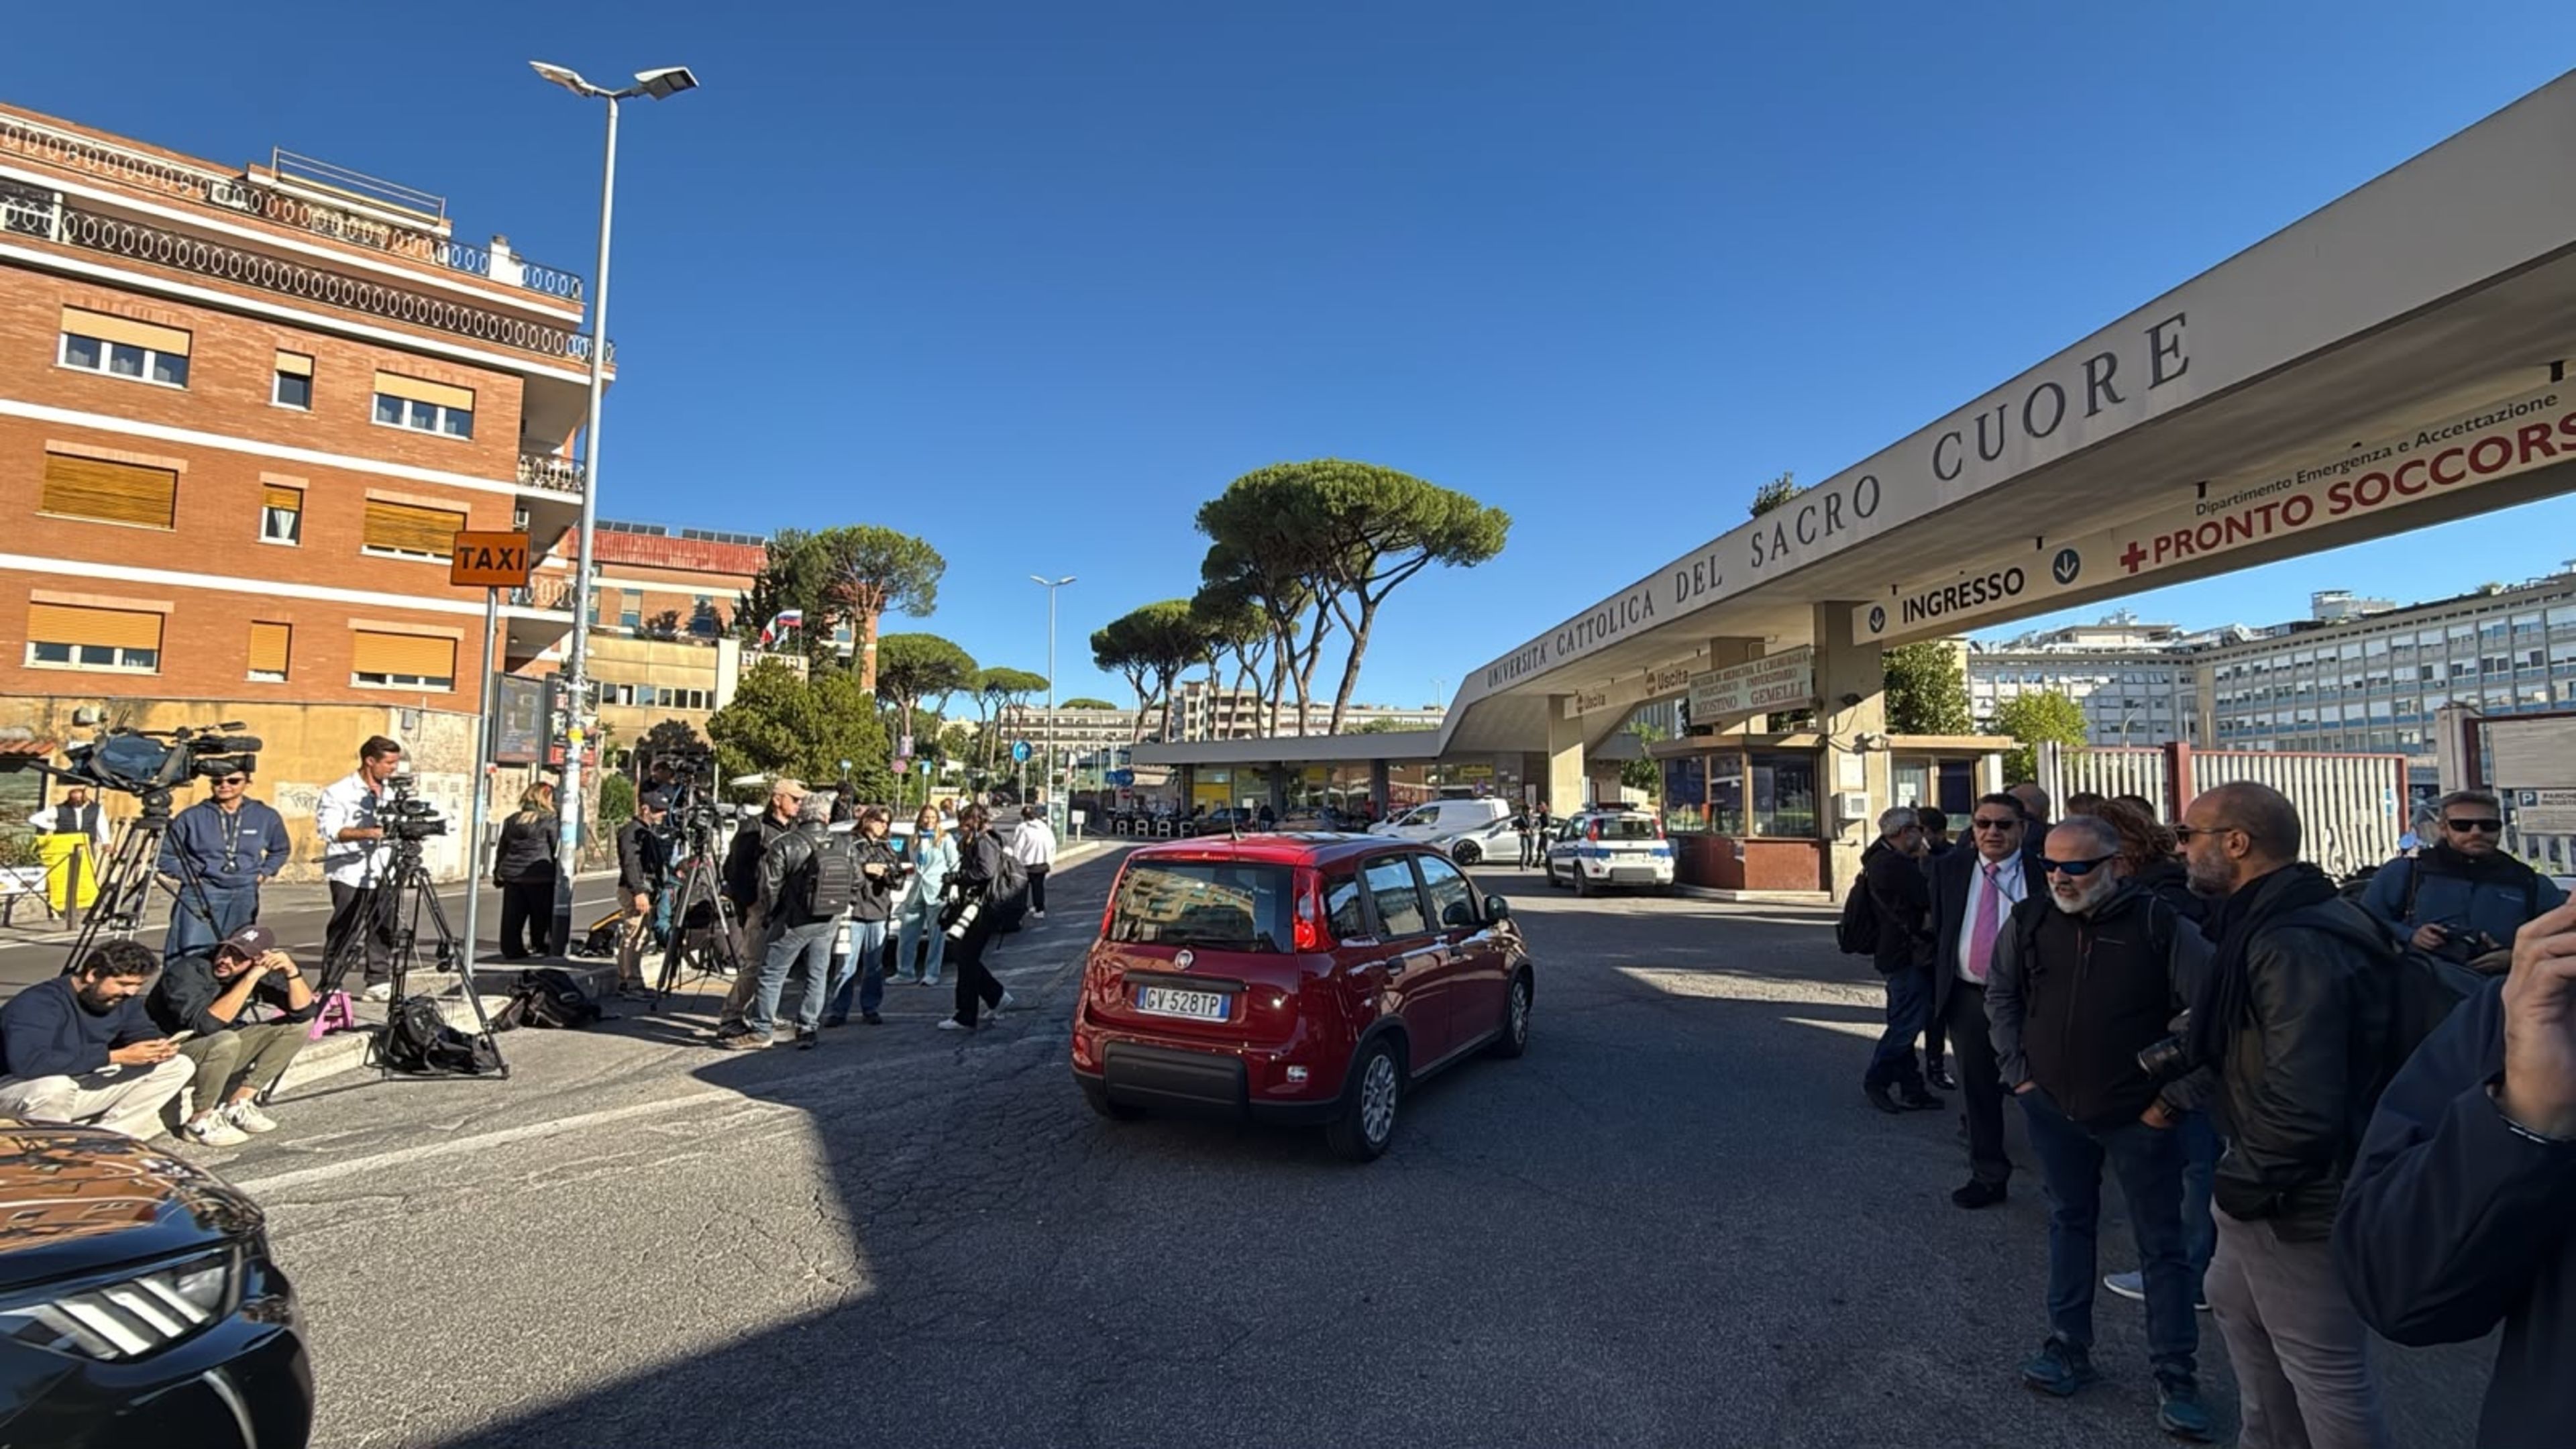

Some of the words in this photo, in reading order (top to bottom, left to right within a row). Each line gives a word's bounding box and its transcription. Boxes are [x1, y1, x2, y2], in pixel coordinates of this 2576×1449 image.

[2196, 478, 2292, 516] Dipartimento
[2296, 447, 2393, 485] Emergenza
[2398, 441, 2409, 453] e
[2414, 392, 2559, 447] Accettazione
[1556, 589, 1655, 657] CATTOLICA
[1675, 554, 1723, 604] DEL
[1751, 474, 1880, 569] SACRO
[1933, 312, 2190, 482] CUORE
[2154, 494, 2314, 564] PRONTO
[459, 547, 525, 571] TAXI
[1902, 567, 2025, 624] INGRESSO
[1658, 669, 1688, 690] Uscita
[1584, 694, 1606, 709] Uscita
[1147, 989, 1166, 1009] GV
[1170, 991, 1219, 1015] 528TP
